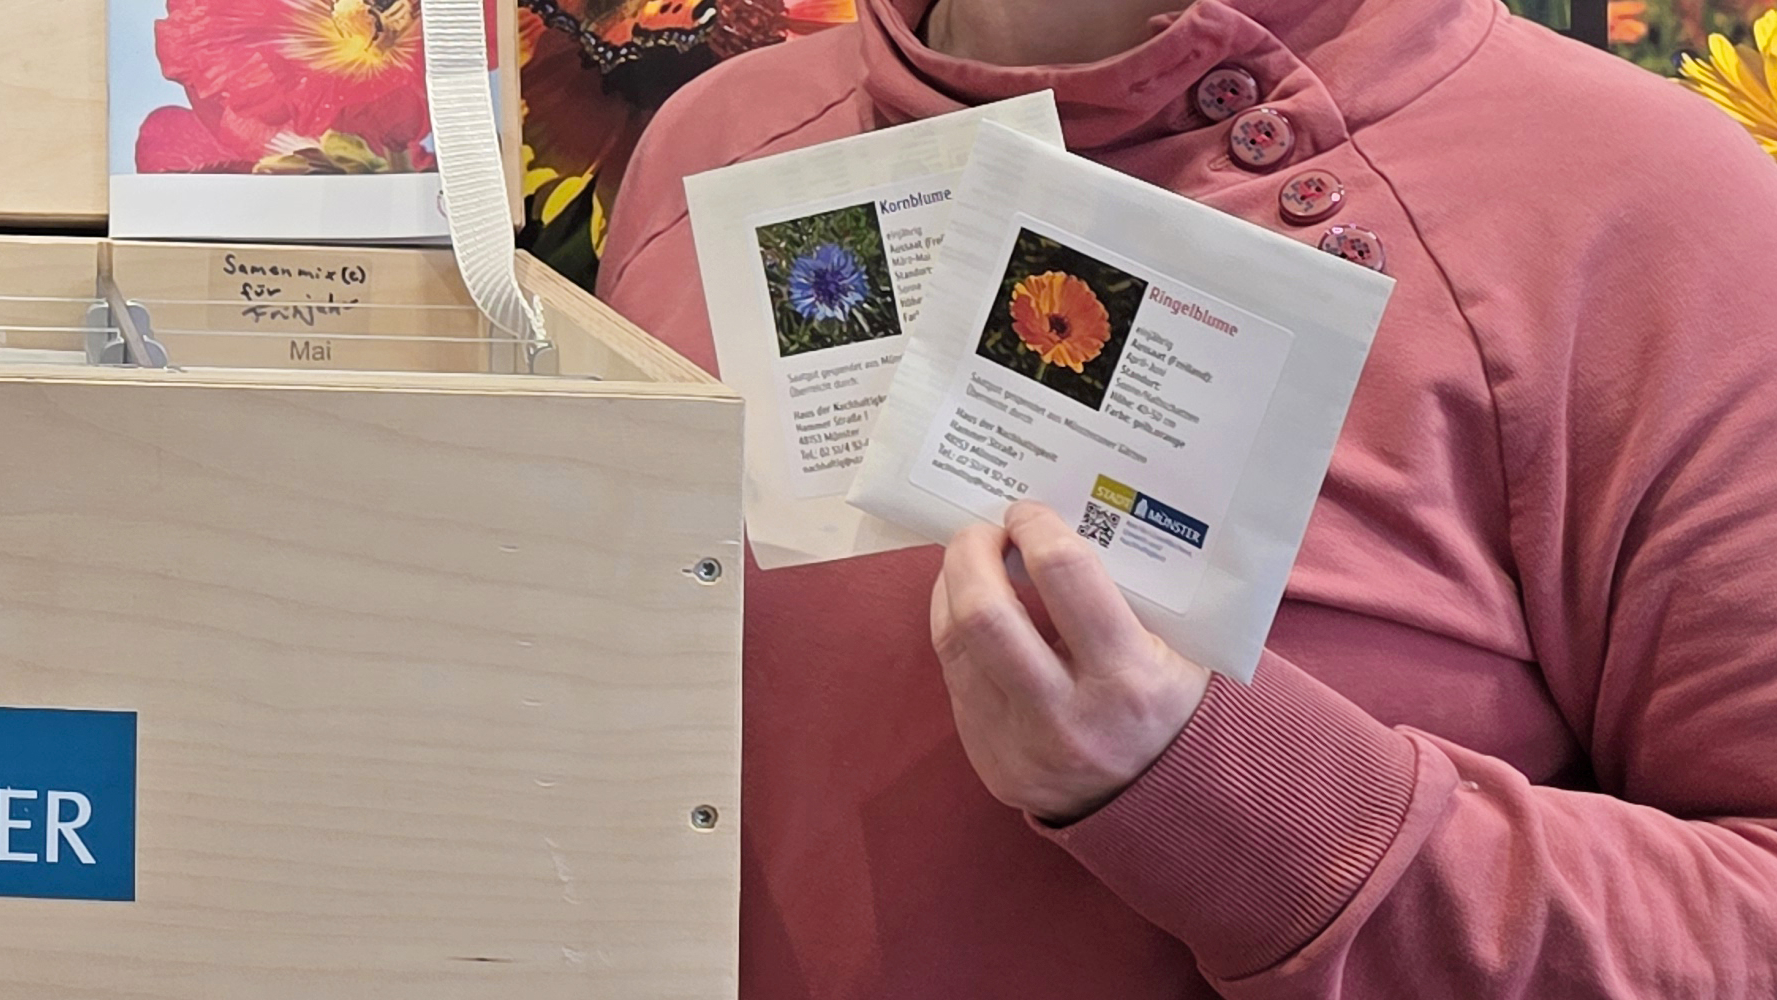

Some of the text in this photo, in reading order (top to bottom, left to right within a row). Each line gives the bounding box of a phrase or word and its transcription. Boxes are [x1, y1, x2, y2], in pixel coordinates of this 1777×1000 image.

[880, 188, 953, 215] Kornblume
[240, 282, 282, 301] für
[1149, 286, 1239, 337] Ringelblume
[289, 339, 332, 361] Mai
[794, 409, 813, 419] Haus
[817, 405, 829, 414] der
[956, 408, 977, 422] Haus
[1097, 486, 1130, 507] STADT
[1148, 509, 1201, 541] MÜNSTER
